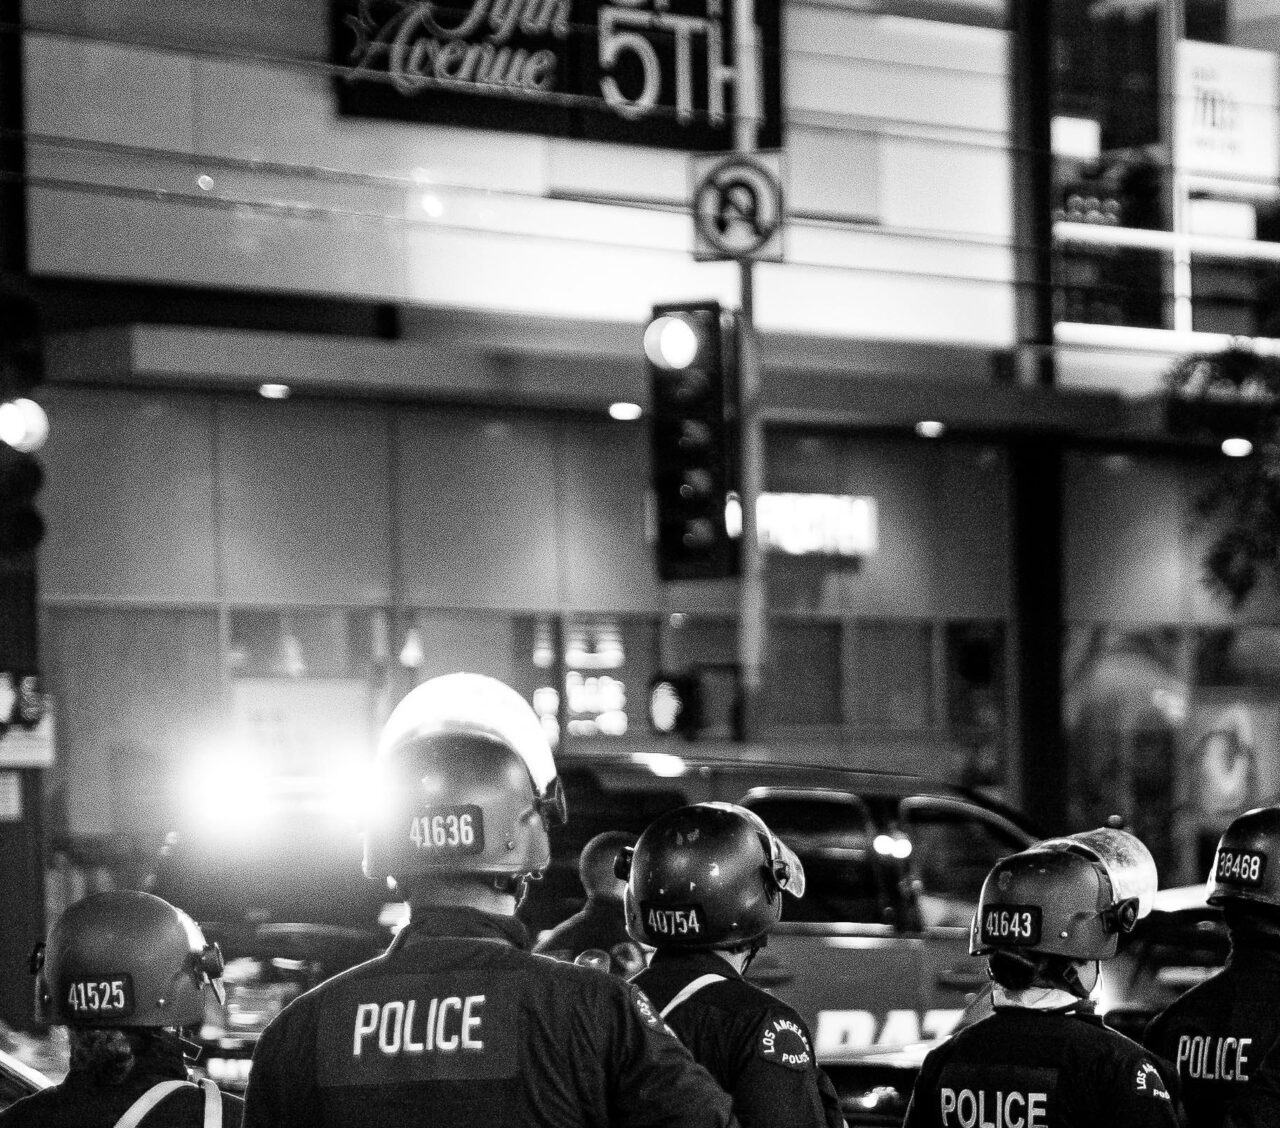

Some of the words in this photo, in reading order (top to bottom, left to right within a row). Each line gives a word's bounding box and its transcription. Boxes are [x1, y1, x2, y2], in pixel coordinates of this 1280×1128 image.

[345, 4, 558, 95] Avenue
[600, 7, 765, 125] 5TH
[409, 814, 475, 847] 41636
[1219, 852, 1260, 880] 38468
[648, 908, 700, 936] 40754
[986, 911, 1031, 937] 41643
[68, 981, 125, 1010] 41525
[353, 995, 485, 1056] POLICE
[762, 1029, 776, 1053] LOS
[1176, 1034, 1252, 1081] POLICE
